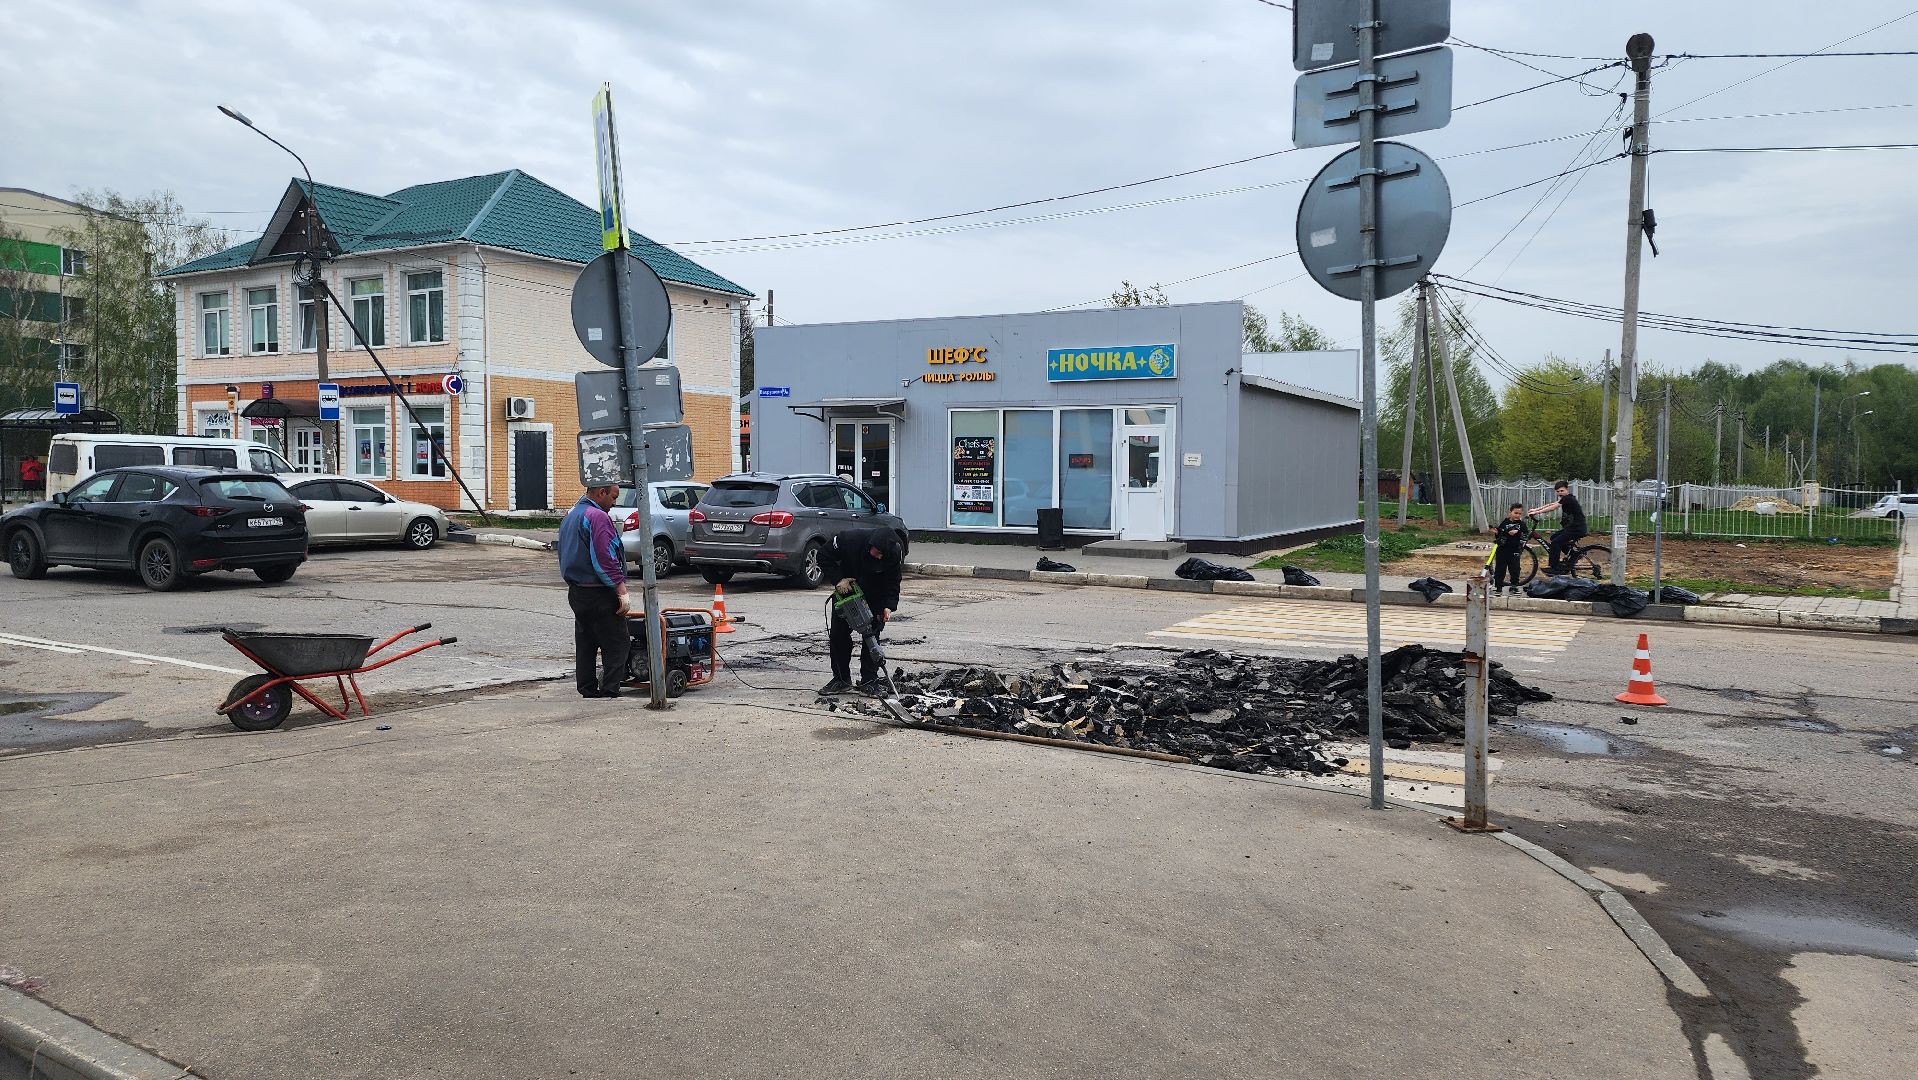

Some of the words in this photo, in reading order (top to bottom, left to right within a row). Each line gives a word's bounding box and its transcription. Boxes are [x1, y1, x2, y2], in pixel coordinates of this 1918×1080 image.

[1059, 351, 1138, 373] НОЧКА
[922, 372, 955, 383] ПИЦЦА
[959, 371, 995, 382] РОЛЛЫ
